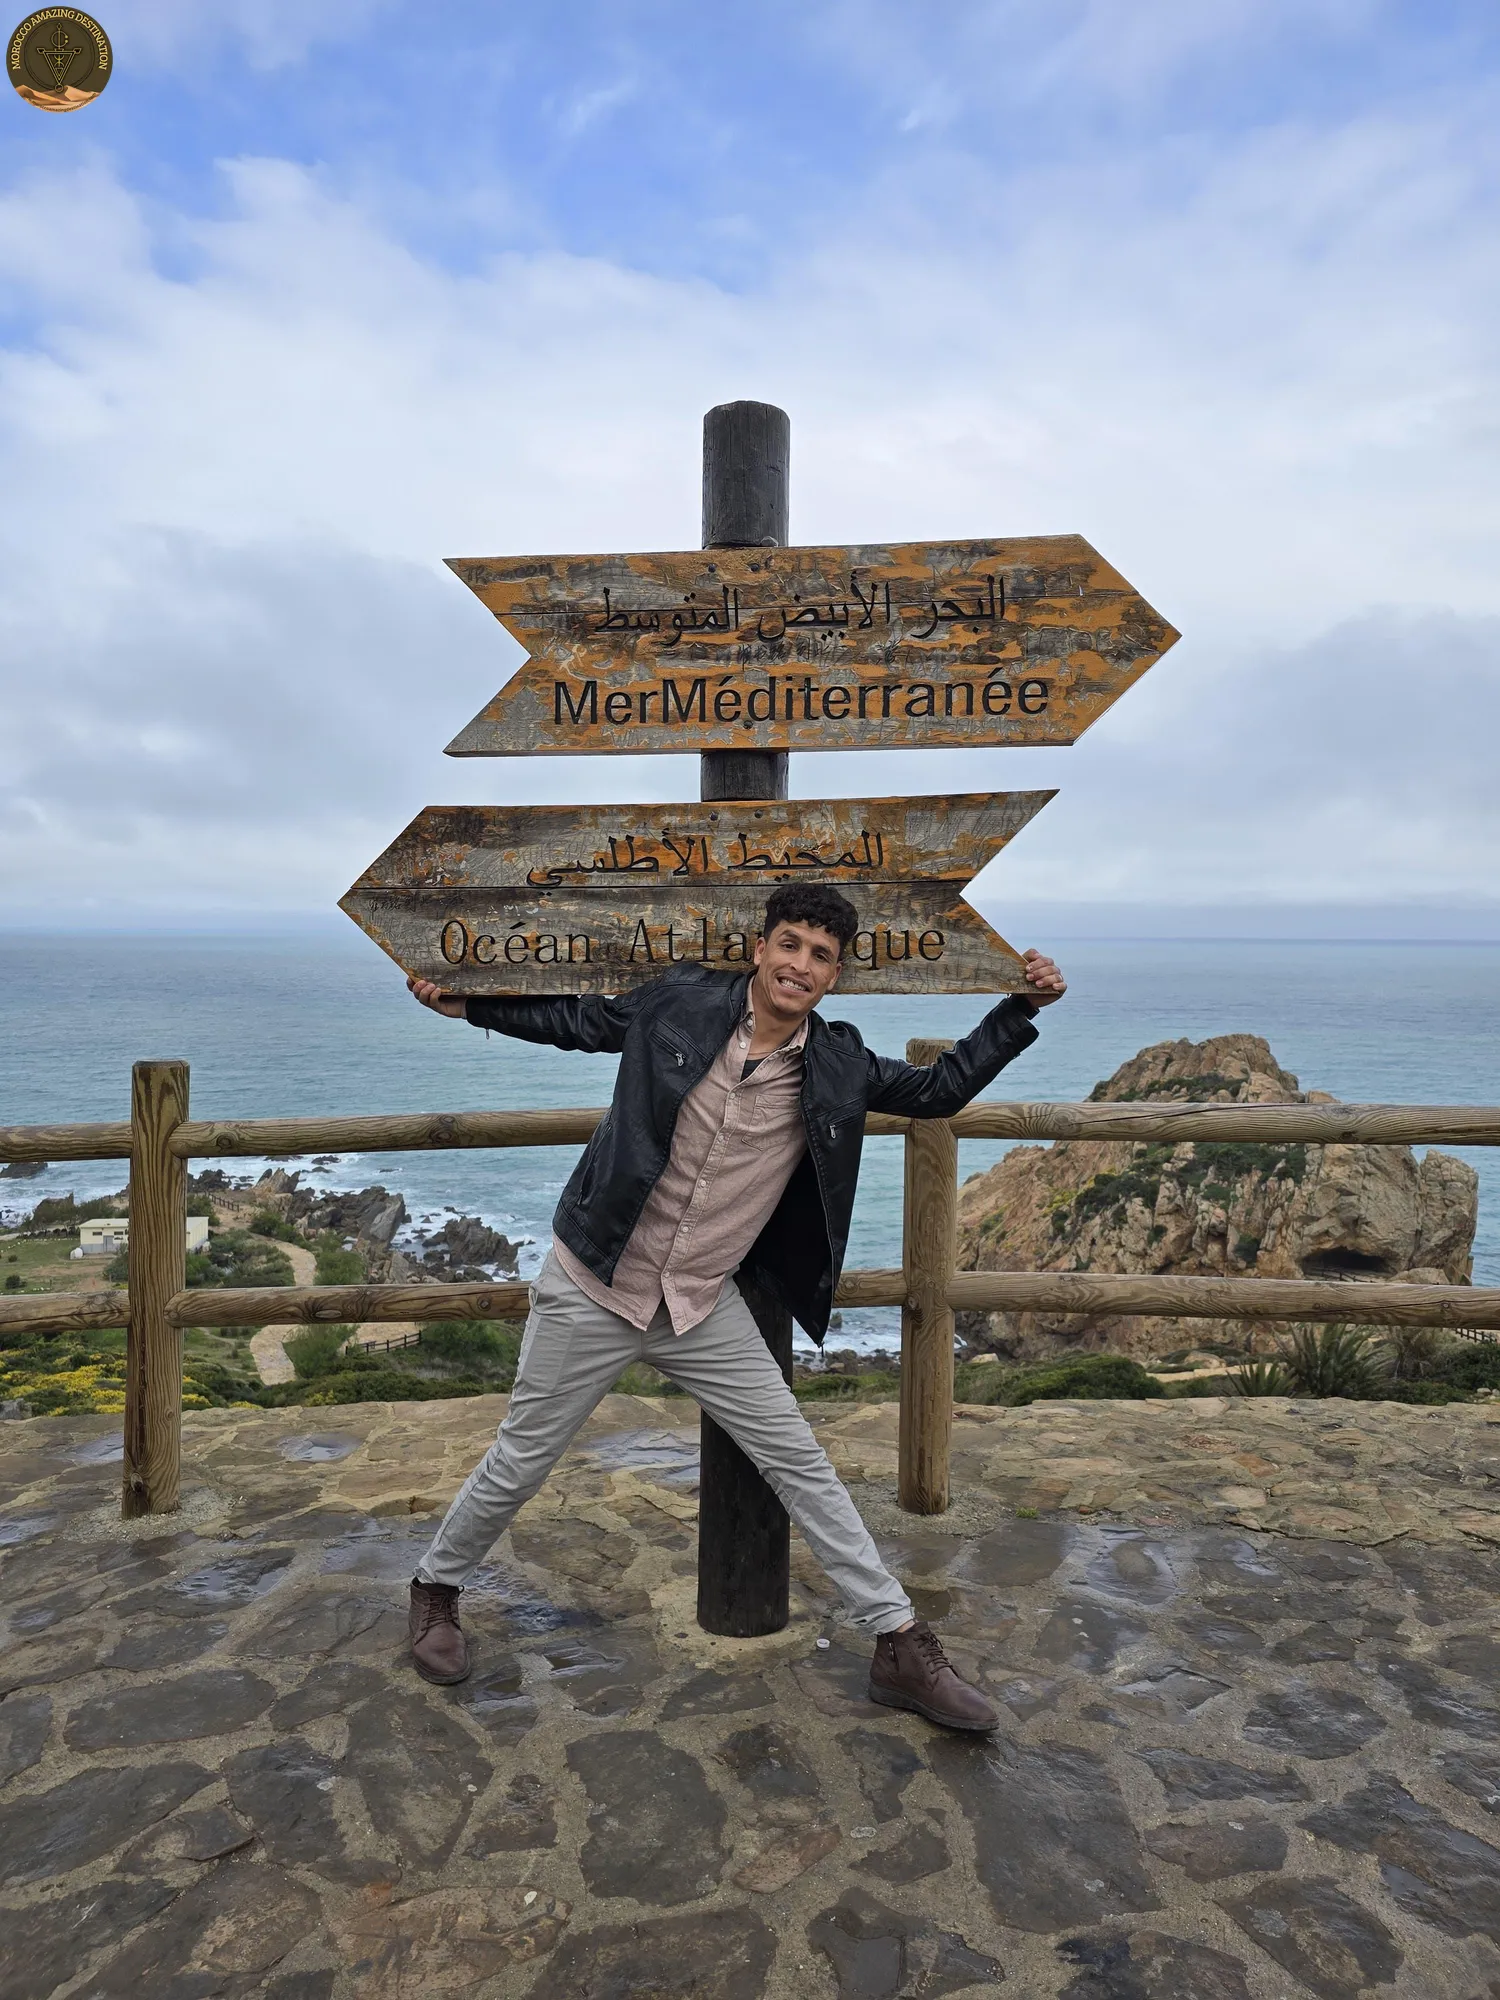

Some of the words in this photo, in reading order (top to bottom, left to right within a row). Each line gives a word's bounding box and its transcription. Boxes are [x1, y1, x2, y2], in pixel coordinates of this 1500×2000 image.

[594, 584, 739, 647] المتوسط
[756, 570, 891, 643] الأبيض
[910, 573, 1005, 640] البحر
[525, 827, 709, 897] الأطلسي
[727, 829, 884, 883] المحيط
[440, 919, 594, 965] Océan
[625, 916, 946, 971] Atlaque
